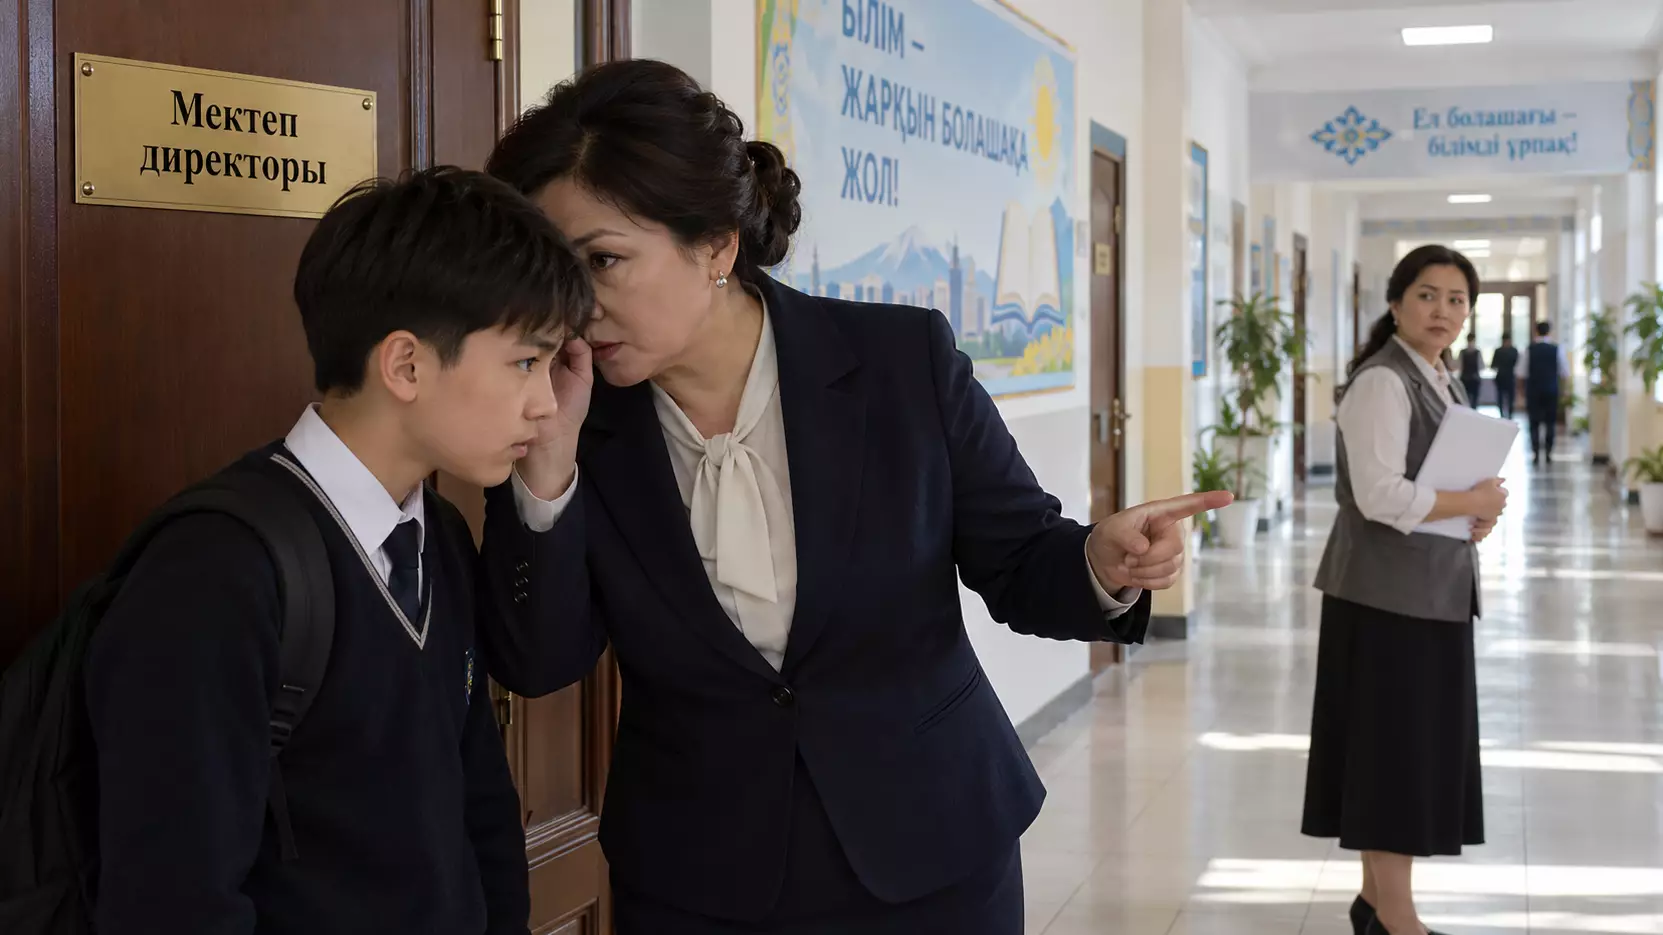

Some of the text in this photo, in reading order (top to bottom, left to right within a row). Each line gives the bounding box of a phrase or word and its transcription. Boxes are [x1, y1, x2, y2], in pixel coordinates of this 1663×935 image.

[170, 89, 298, 138] Мектеп
[841, 64, 1029, 177] ЖАРҚЫН БОЛАШАҚА
[1413, 107, 1440, 130] Ел
[140, 145, 327, 192] директоры
[841, 146, 899, 208] ЖОЛ!
